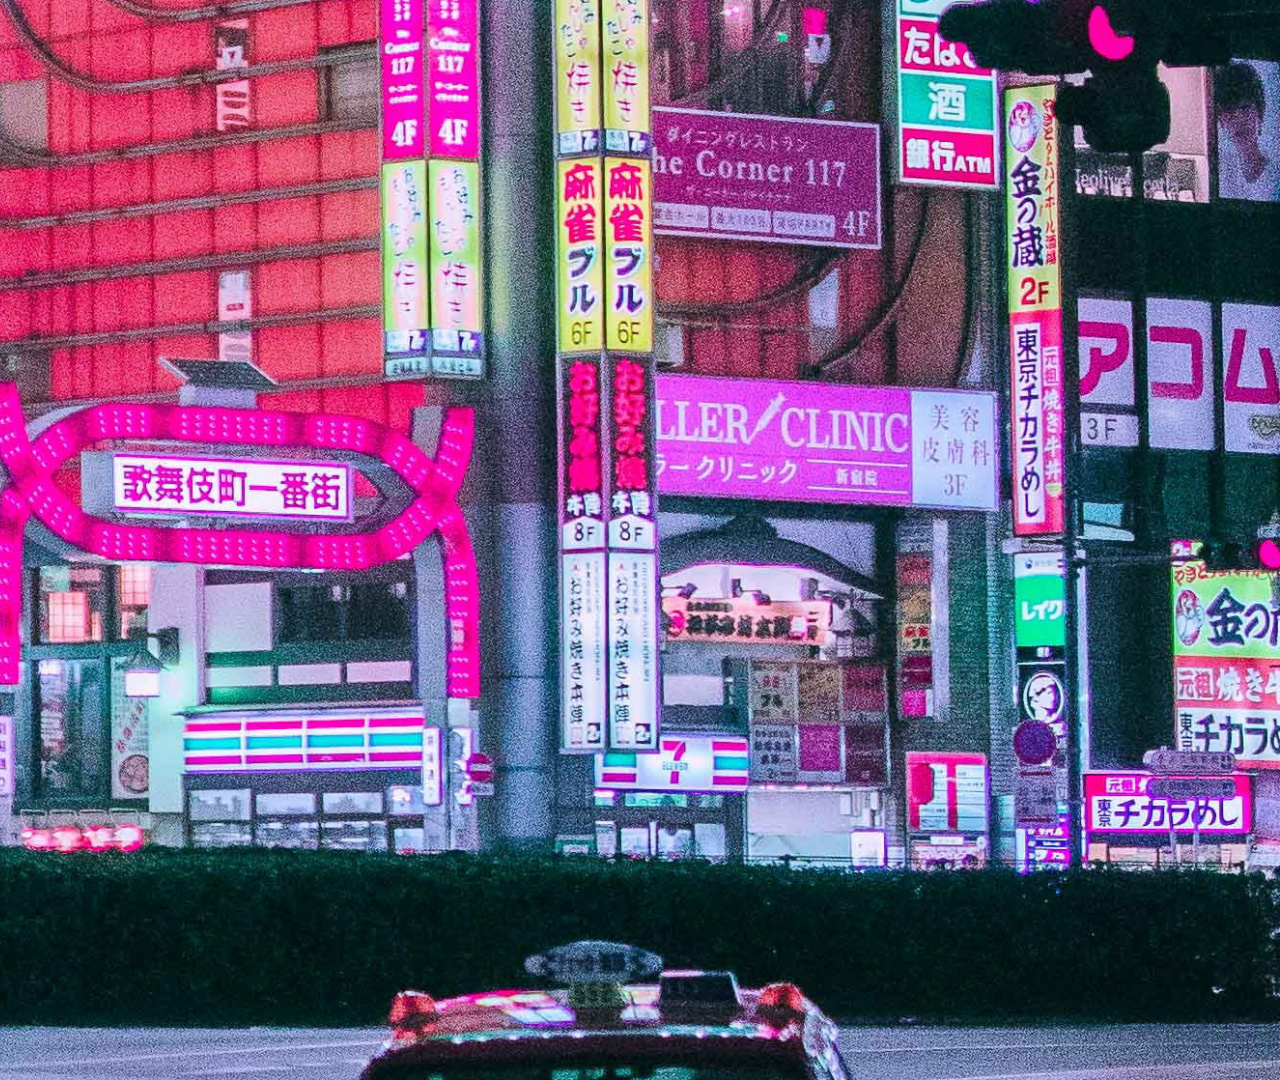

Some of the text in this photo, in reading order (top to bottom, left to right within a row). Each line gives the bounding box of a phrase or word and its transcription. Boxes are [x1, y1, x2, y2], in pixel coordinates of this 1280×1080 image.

[391, 57, 415, 75] 117
[437, 56, 465, 73] 117
[927, 82, 967, 123] 酒
[391, 119, 418, 147] 4F
[438, 118, 469, 146] 4F
[667, 125, 811, 153] ダイニングレストラン
[651, 147, 847, 188] he Corner 117
[905, 138, 991, 175] 銀行ATM
[842, 210, 871, 238] 4F
[1010, 154, 1044, 269] 金の蔵
[563, 163, 597, 313] 麻雀ブル
[609, 162, 644, 313] 麻雀ブル
[1019, 277, 1051, 307] 2F
[571, 321, 593, 346] 6F
[618, 320, 641, 345] 6F
[1078, 320, 1280, 406] アコム
[780, 406, 909, 453] CLINIC
[933, 404, 980, 432] 美容
[1015, 327, 1041, 520] 東京チカラめし
[1086, 417, 1117, 441] 3F
[922, 437, 990, 466] 皮膚科
[122, 463, 341, 512] 歌舞伎町一番街
[835, 468, 879, 488] 新宿院
[943, 474, 968, 497] 3F
[574, 522, 595, 543] 8F
[619, 521, 644, 543] 8F
[1020, 599, 1065, 621] レイク
[1178, 670, 1214, 700] 元祖
[1106, 777, 1136, 793] 元祖
[1097, 797, 1240, 828] 東京 チカラめし
